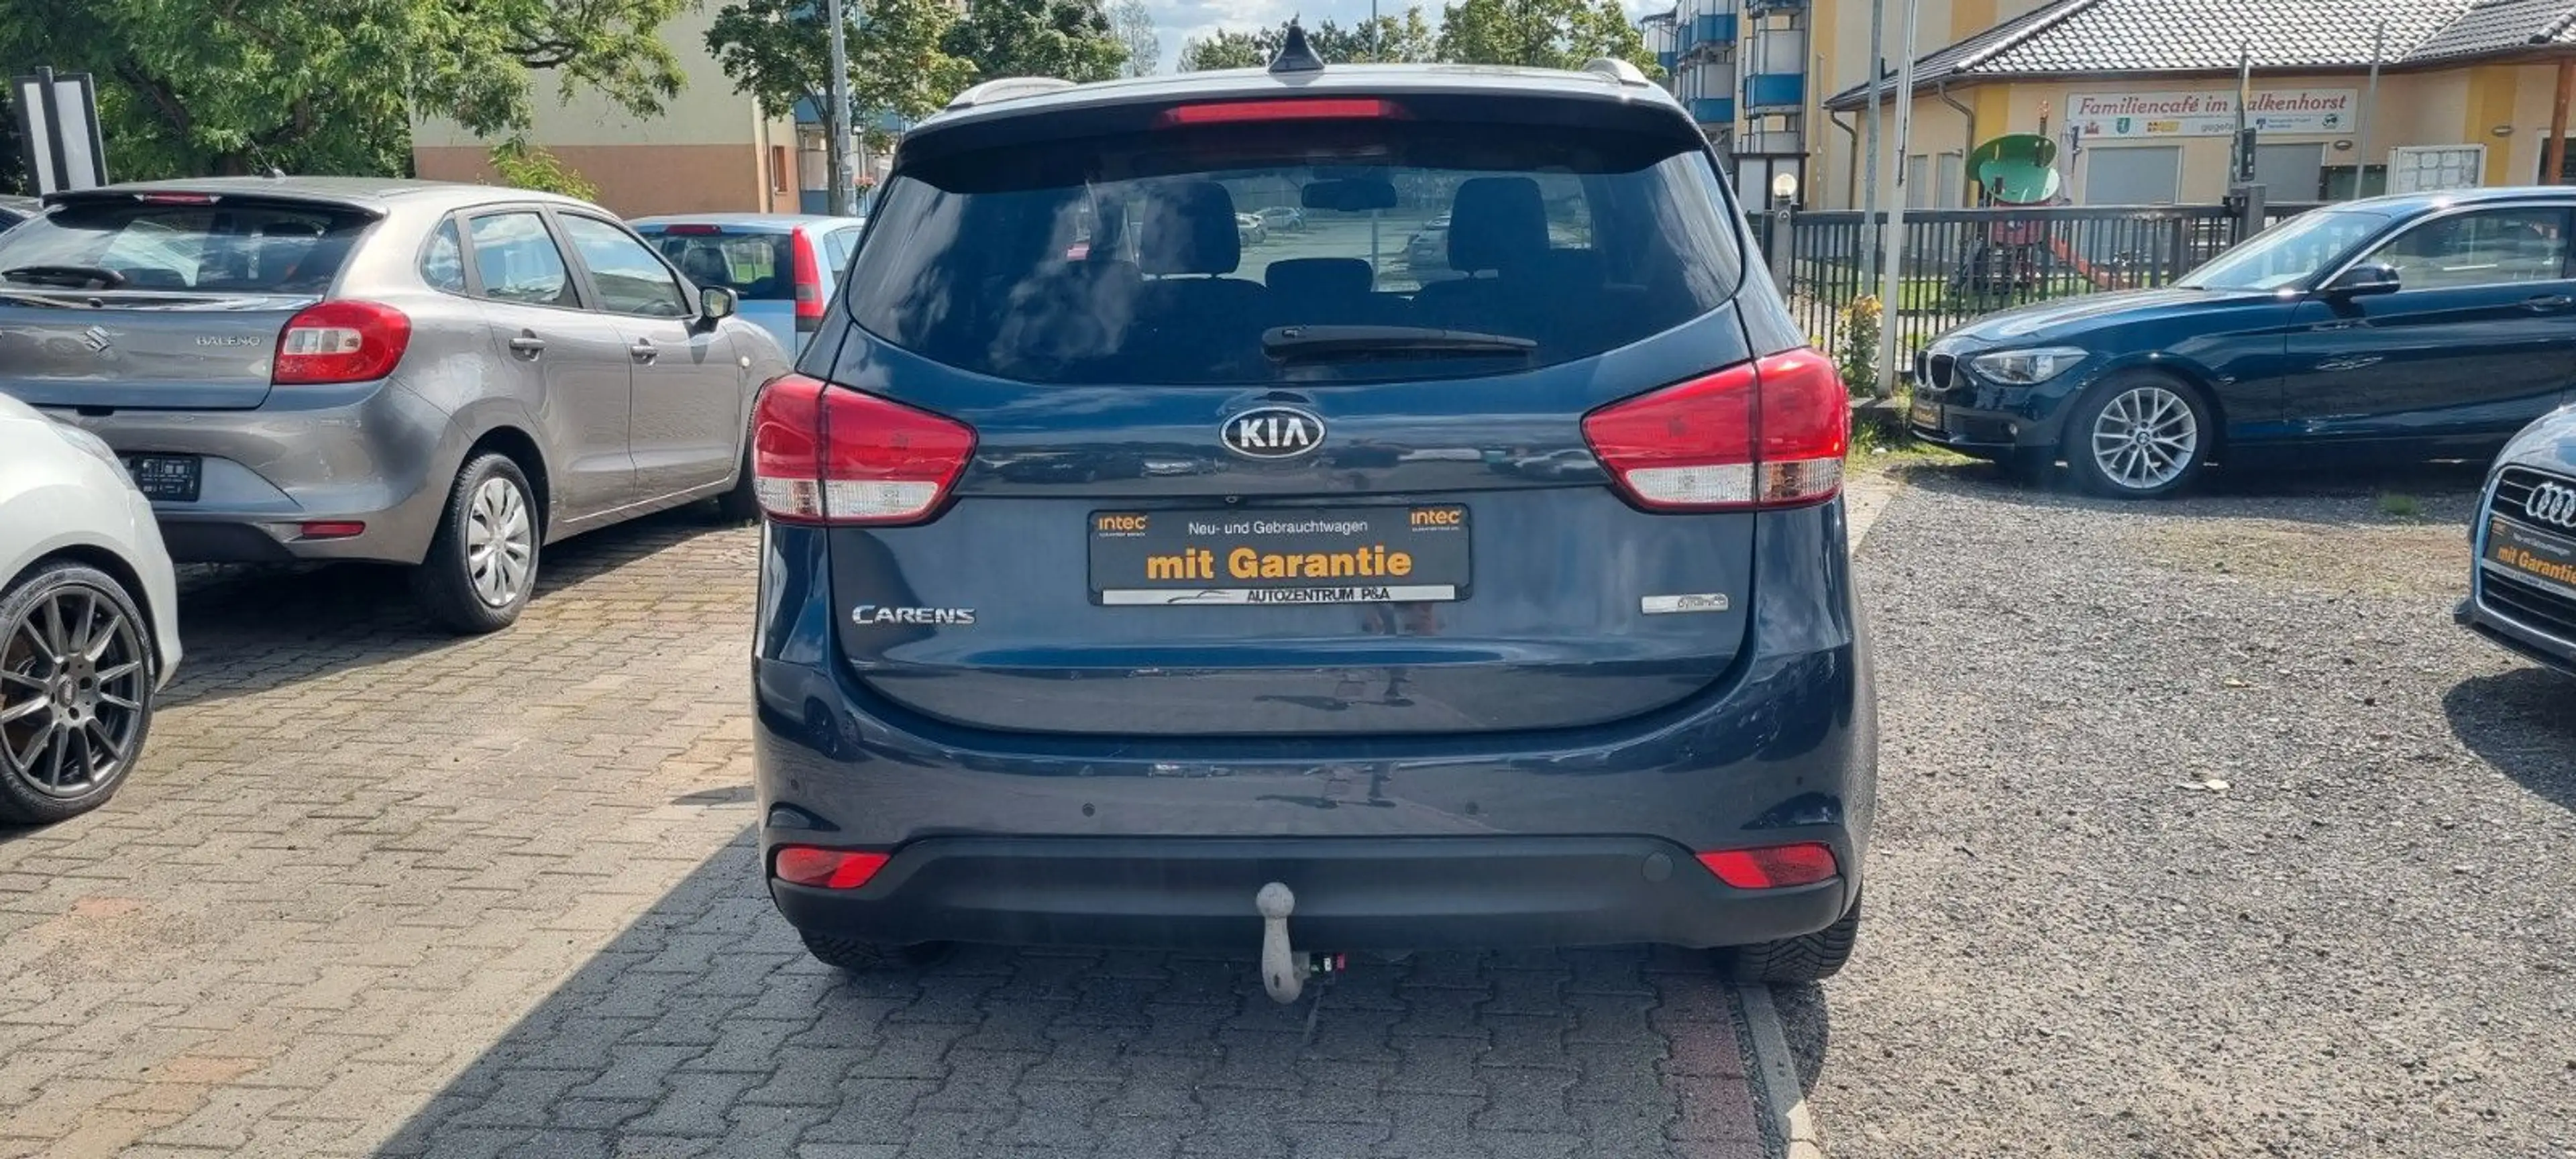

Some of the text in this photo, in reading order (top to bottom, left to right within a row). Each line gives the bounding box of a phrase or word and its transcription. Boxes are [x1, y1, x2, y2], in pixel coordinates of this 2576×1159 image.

[2078, 96, 2200, 115] Familiencafé
[2205, 95, 2228, 113] im
[196, 335, 261, 347] BALENO
[1240, 418, 1309, 447] KIA
[1189, 520, 1368, 535] Neu- und Gebrauchtwagen
[1147, 544, 1411, 579] mit Garantie
[2497, 545, 2517, 564] mit
[2519, 551, 2576, 586] Garantie
[1248, 587, 1391, 602] AUTOZENTRUM P&A
[852, 605, 975, 624] CARENS
